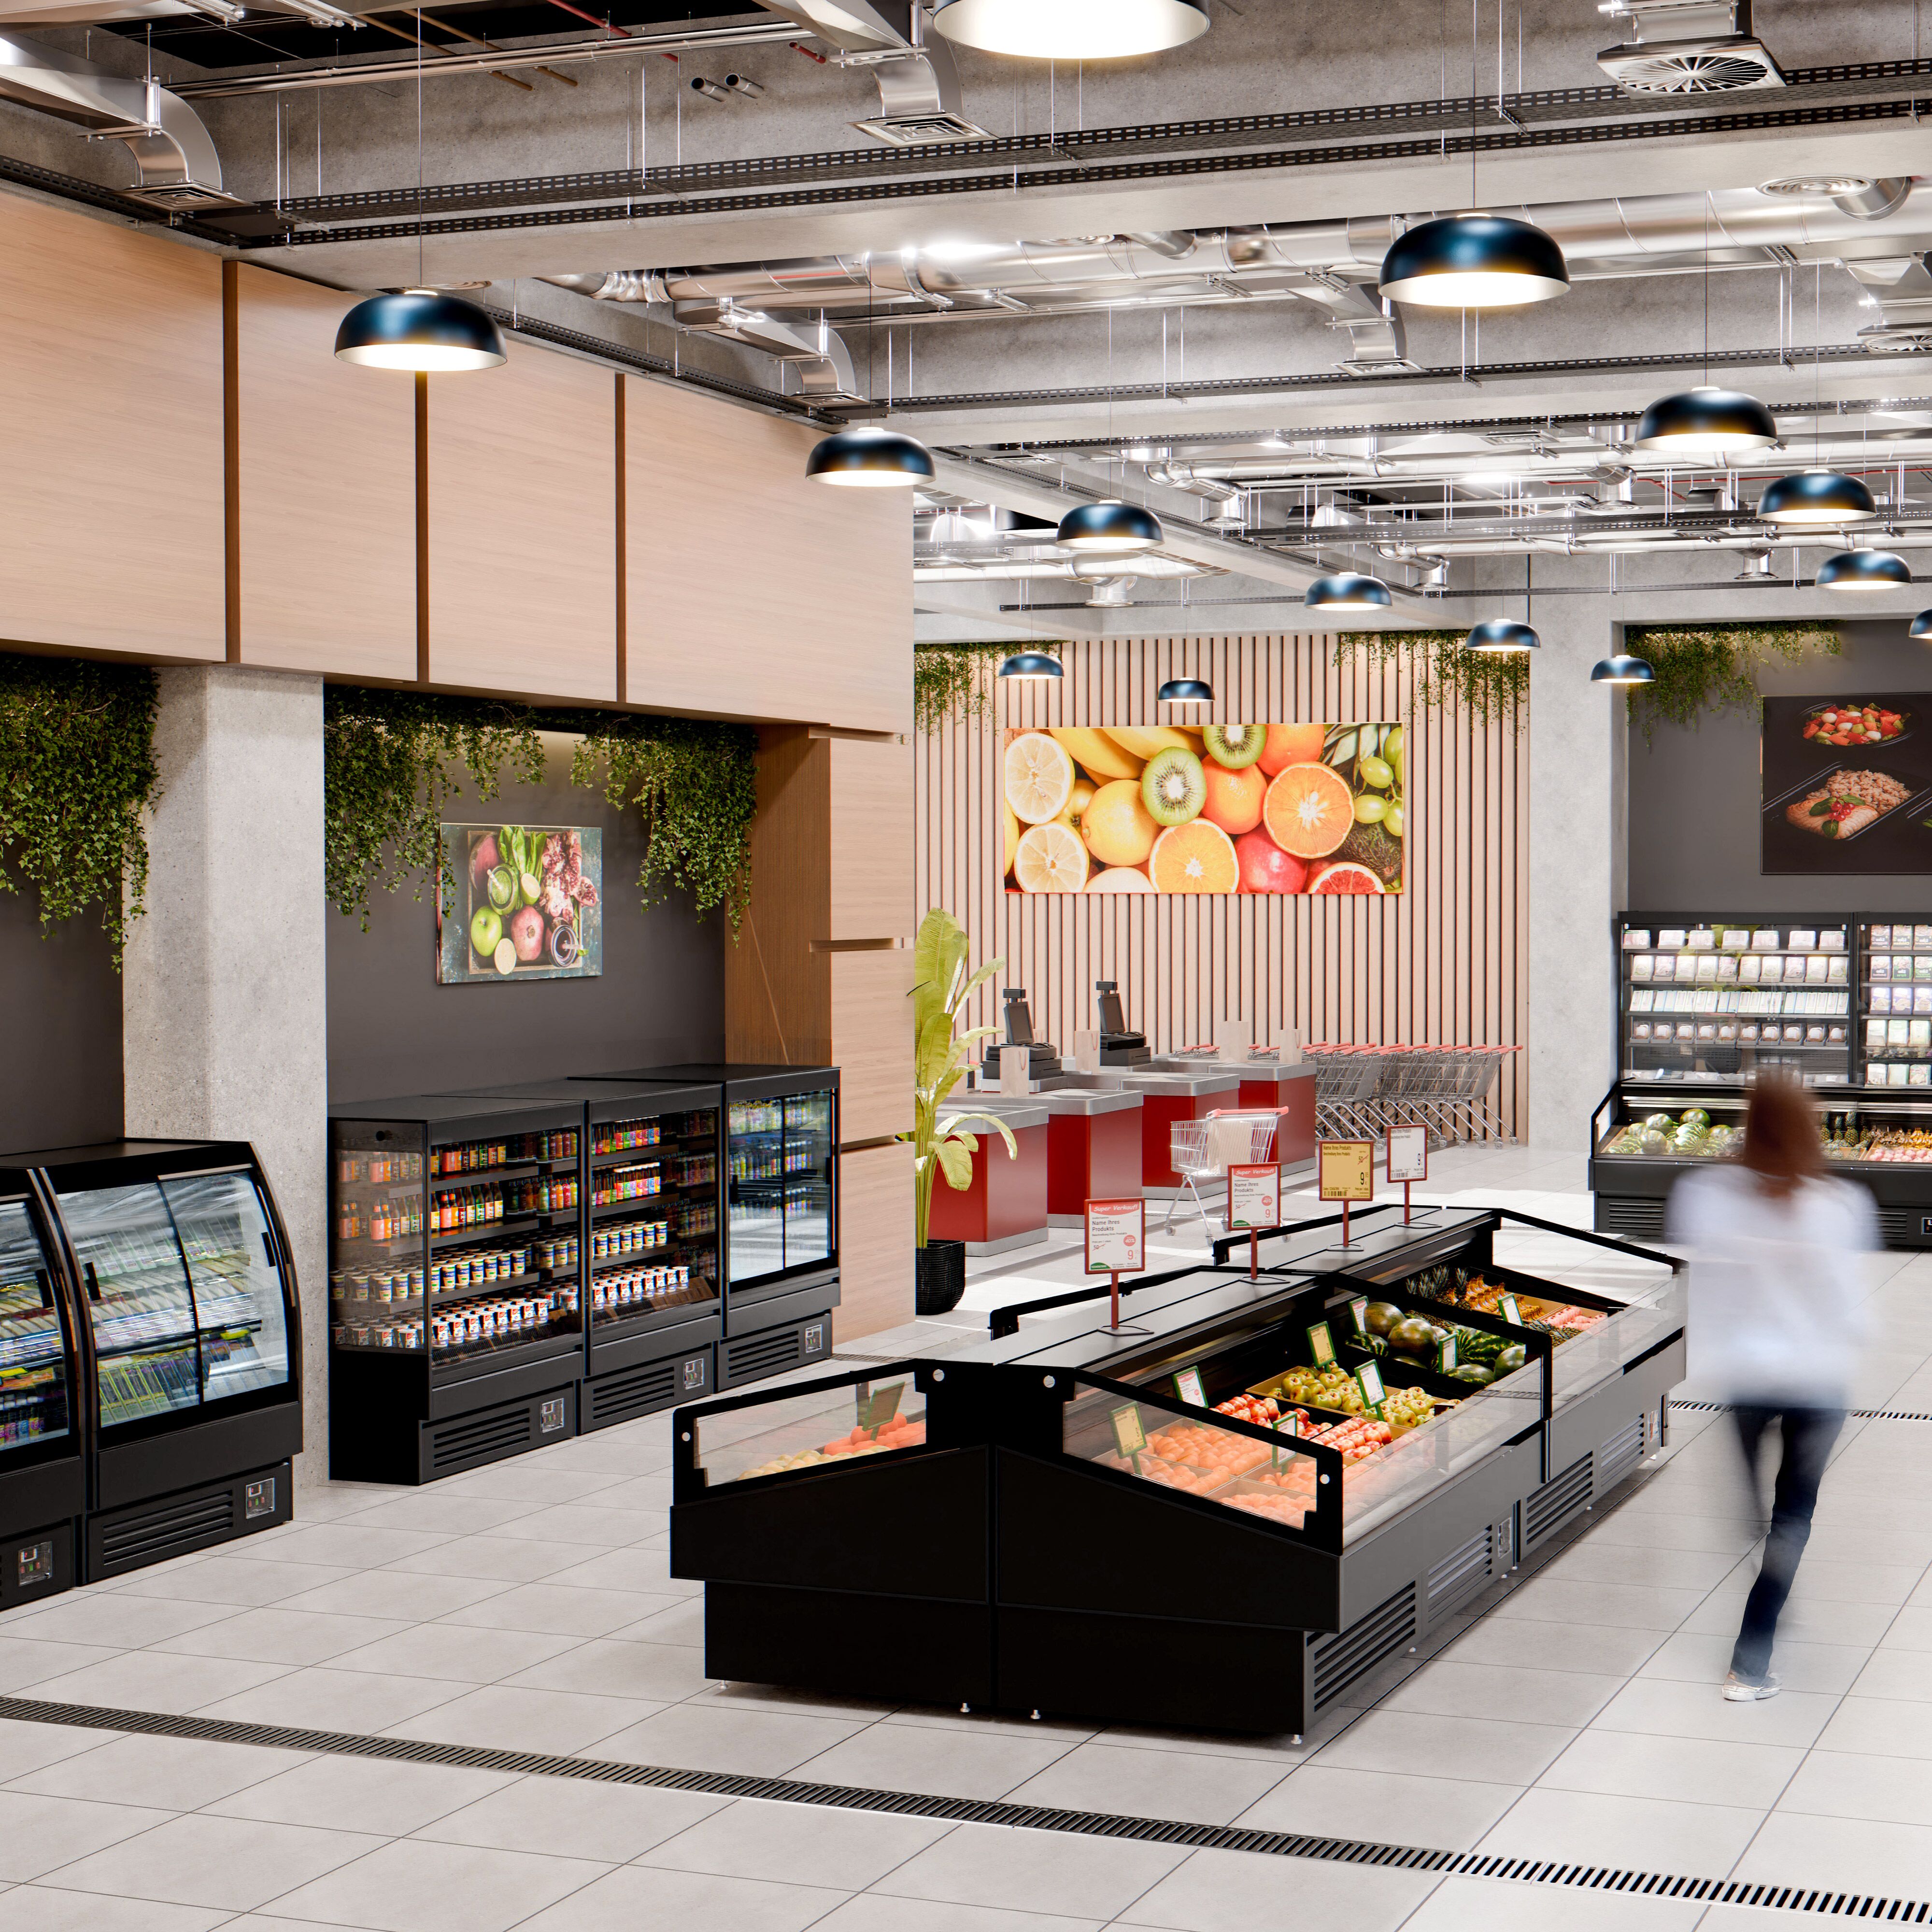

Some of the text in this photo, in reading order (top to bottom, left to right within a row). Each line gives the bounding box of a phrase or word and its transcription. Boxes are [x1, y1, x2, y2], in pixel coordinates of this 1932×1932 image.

[1360, 1172, 1364, 1185] 9
[1265, 1209, 1270, 1218] 9
[1127, 1250, 1134, 1260] 9
